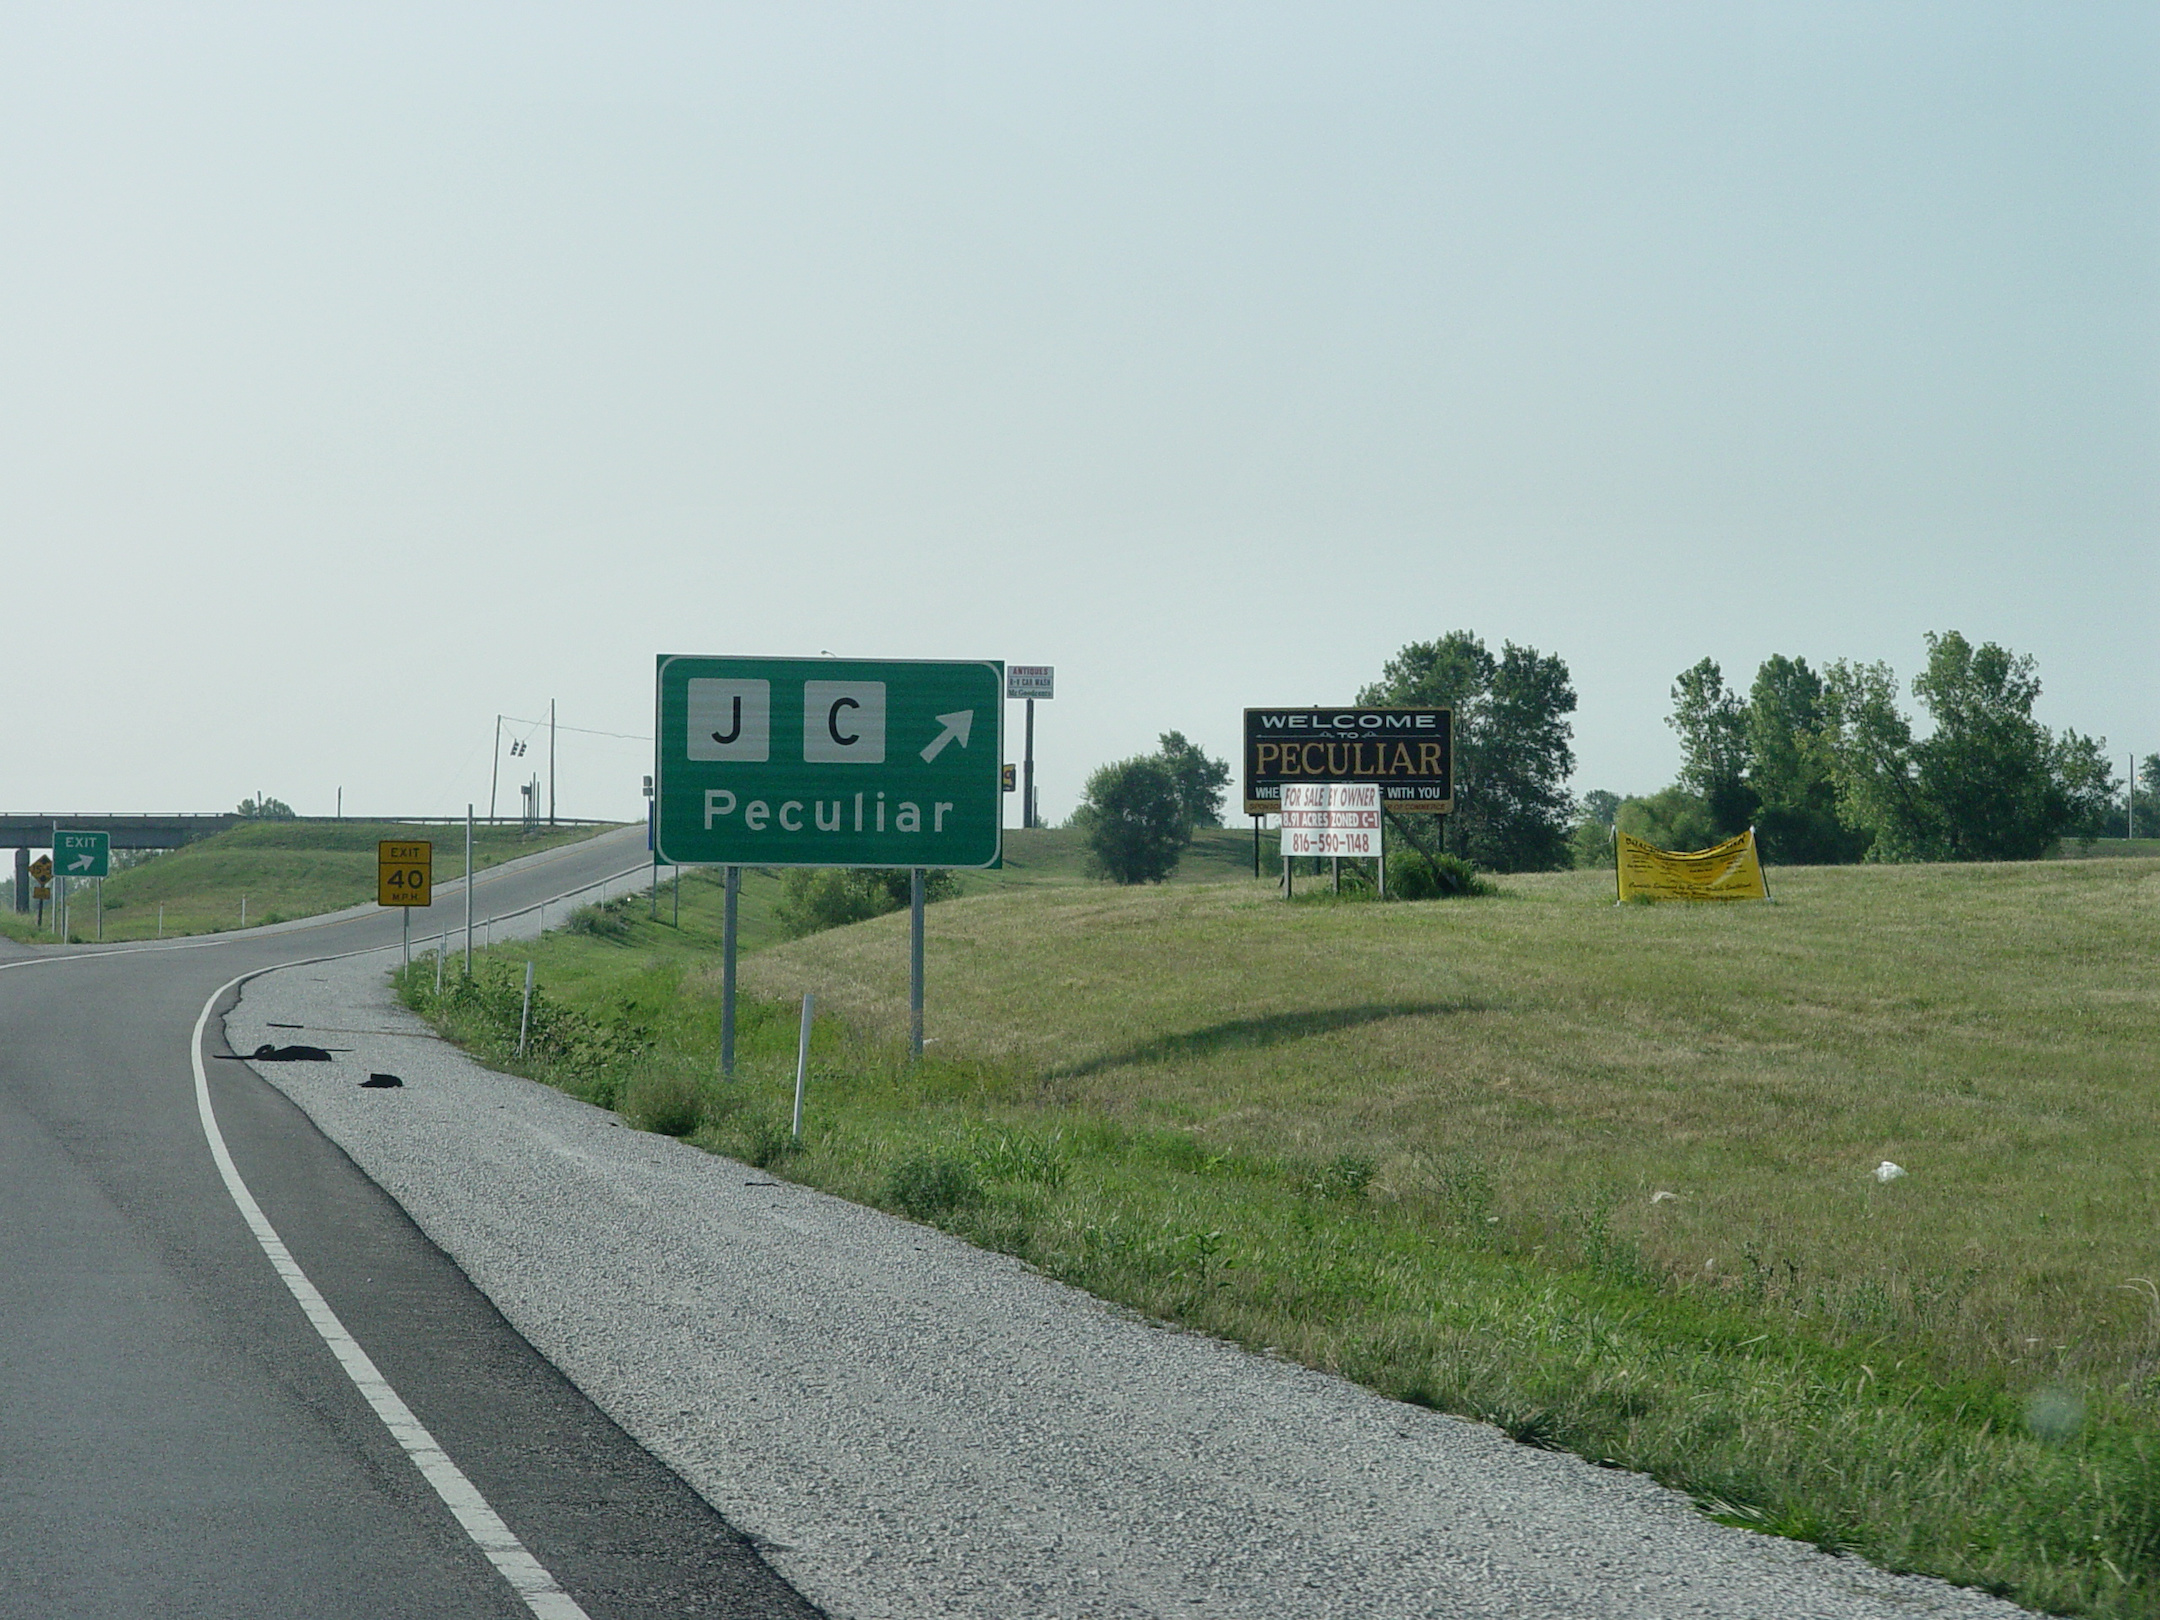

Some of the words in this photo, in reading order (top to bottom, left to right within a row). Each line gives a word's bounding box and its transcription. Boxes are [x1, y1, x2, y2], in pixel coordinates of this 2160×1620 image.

[1013, 667, 1049, 675] ANTIQUES
[711, 695, 742, 744] J
[828, 696, 860, 746] C
[1261, 715, 1436, 729] WELCOME
[1337, 731, 1359, 739] TO
[1256, 742, 1443, 775] PECULIAR
[1284, 787, 1301, 806] FOR
[1304, 787, 1324, 806] SALE
[1328, 787, 1338, 806] BY
[1340, 787, 1376, 806] OWNER
[1387, 787, 1415, 799] WITH
[1418, 787, 1441, 799] YOU
[704, 789, 954, 832] Peculiar
[1405, 803, 1446, 811] COMMERCE
[1283, 812, 1300, 827] 8.91
[1302, 812, 1328, 827] ACRES
[1331, 812, 1359, 827] ZONED
[1362, 812, 1378, 827] C-1
[65, 836, 97, 848] EXIT
[1293, 833, 1370, 852] 816-590-1148
[391, 847, 420, 858] EXIT
[387, 869, 423, 889] 40
